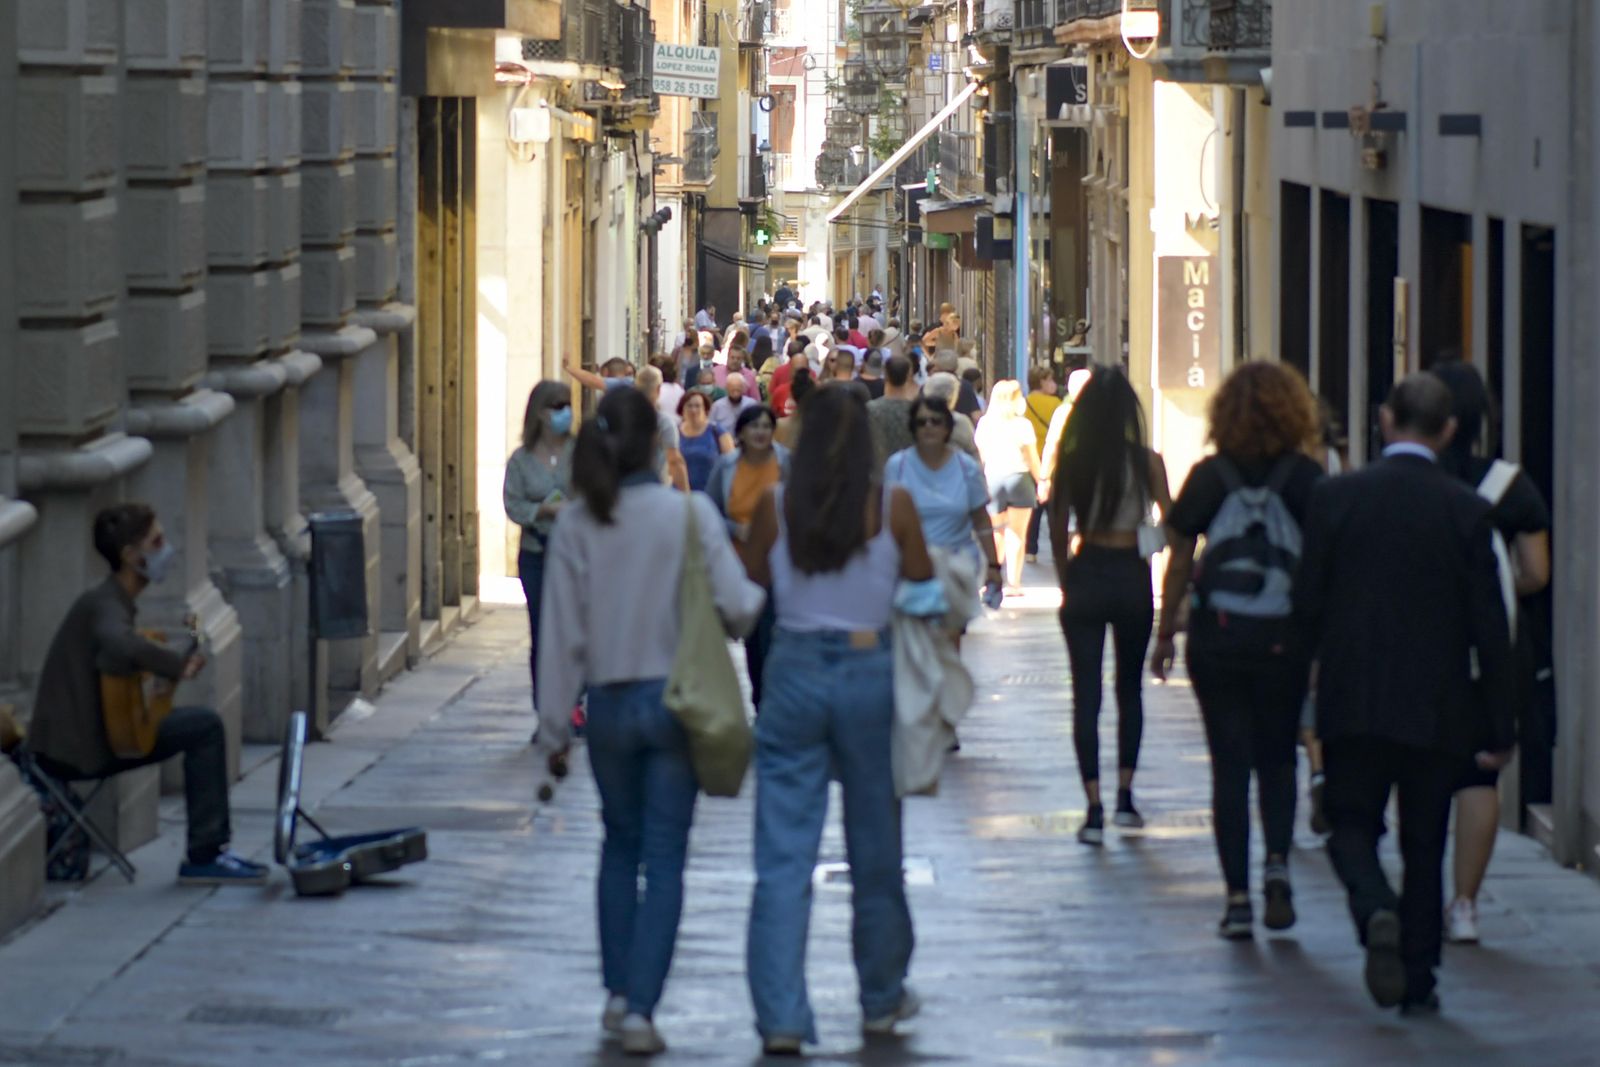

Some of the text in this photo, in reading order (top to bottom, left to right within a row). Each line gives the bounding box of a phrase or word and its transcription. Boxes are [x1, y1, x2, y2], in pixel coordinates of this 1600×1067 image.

[657, 45, 717, 61] ALQUILA
[656, 62, 716, 74] LOPEZ ROMAN
[654, 80, 715, 95] 958 26 53 55
